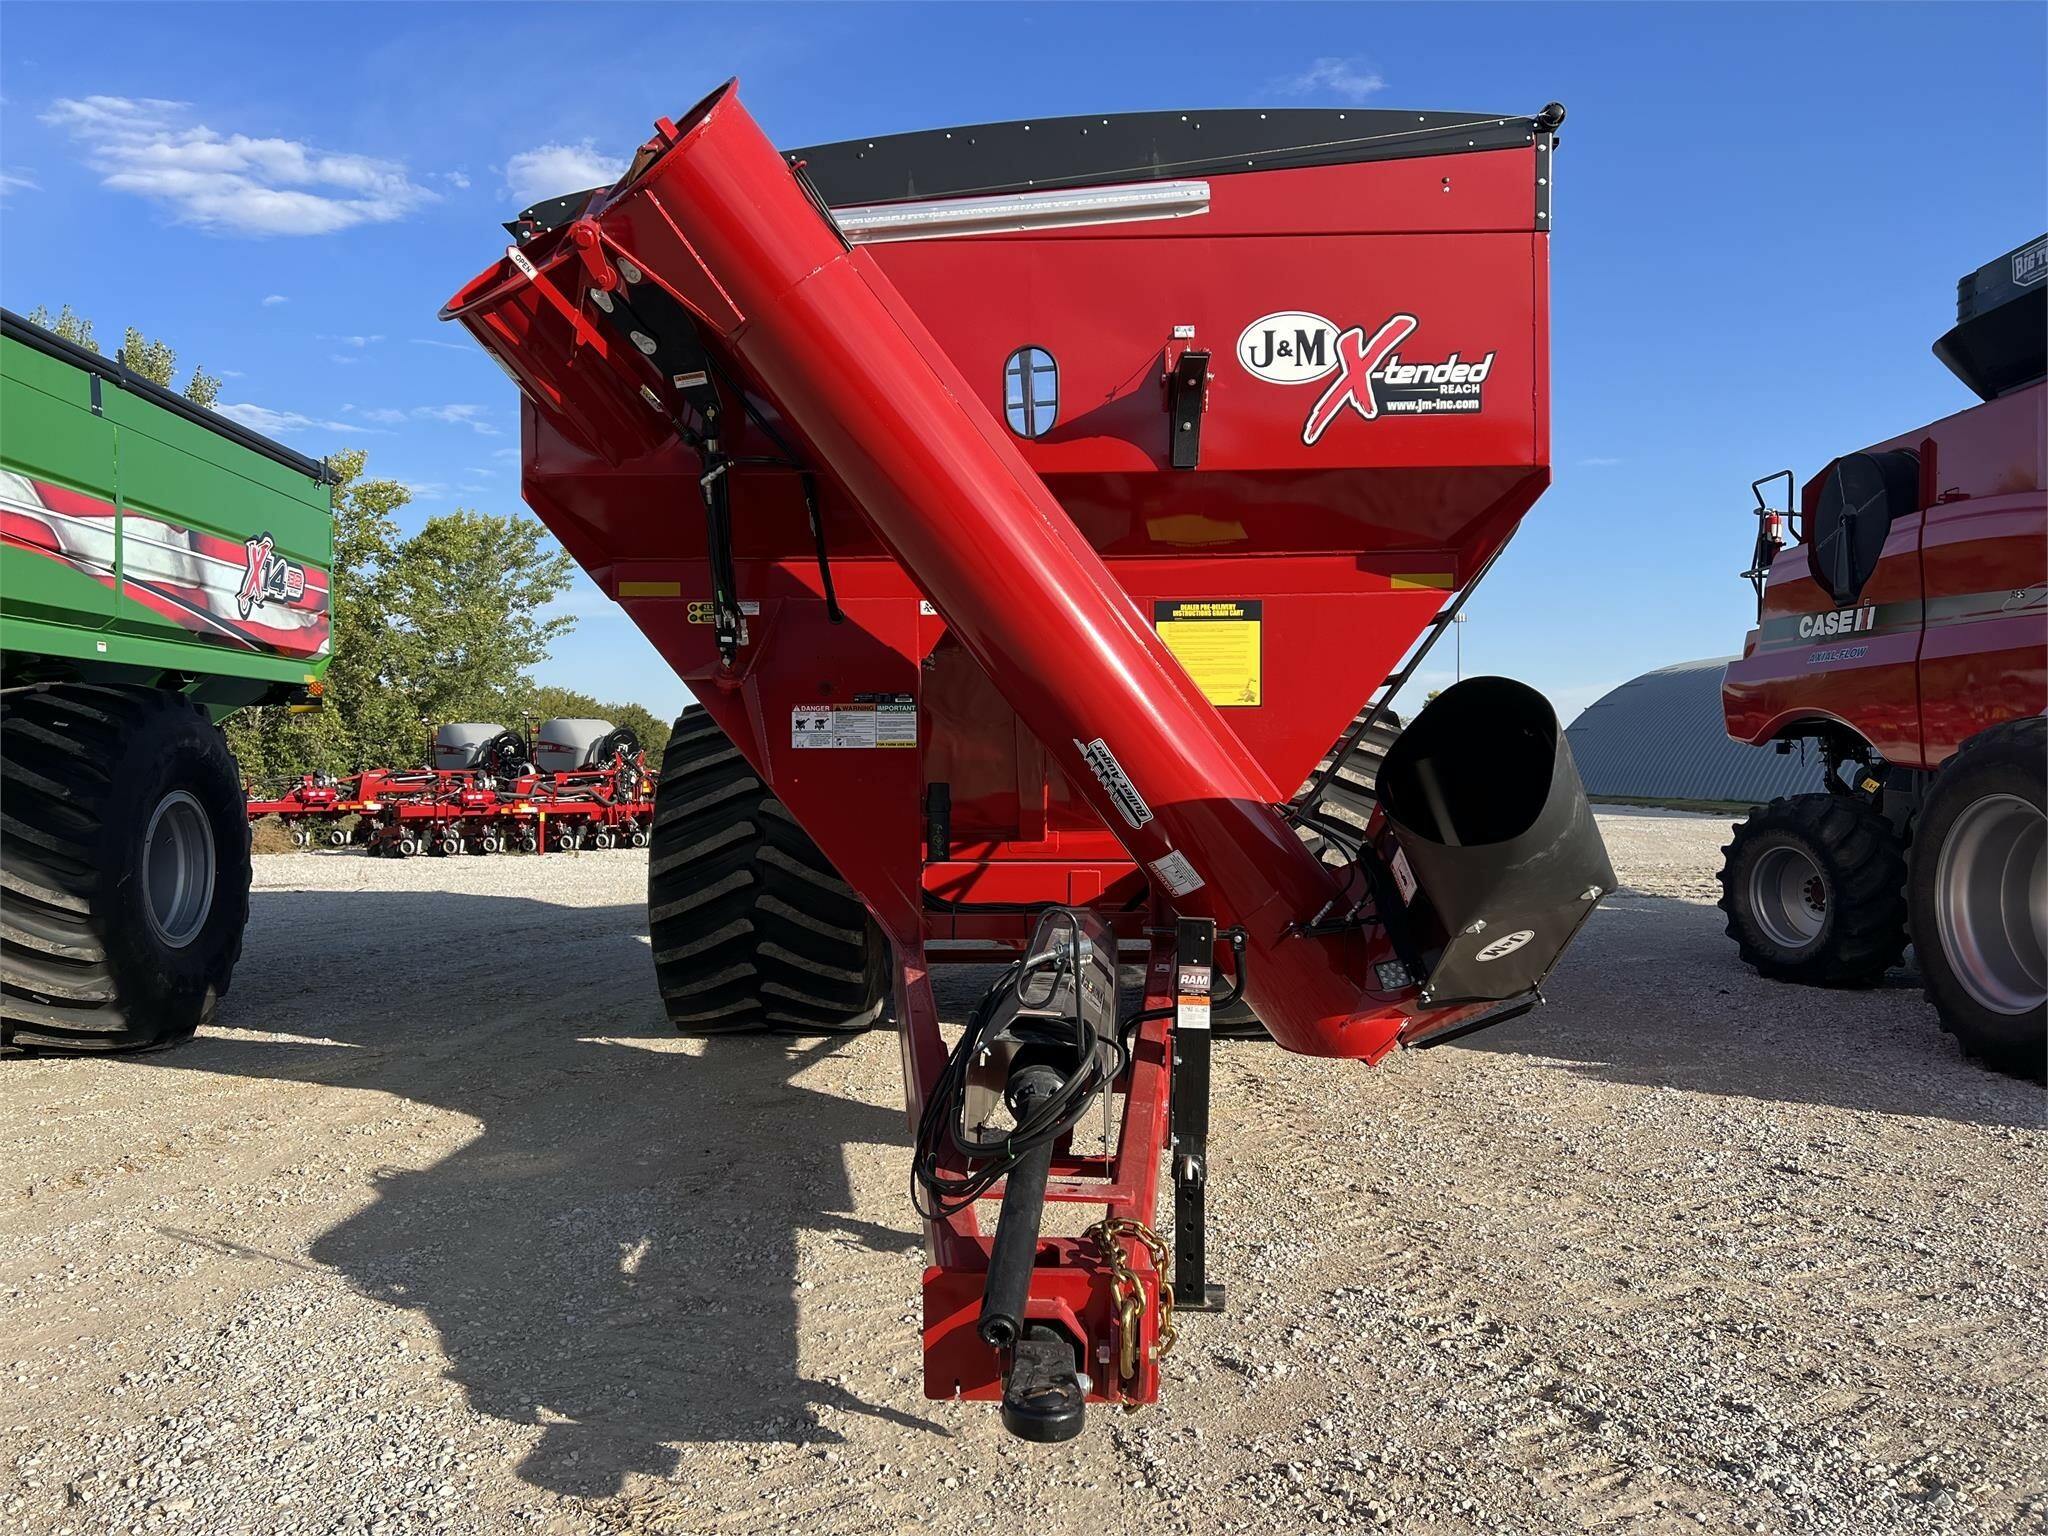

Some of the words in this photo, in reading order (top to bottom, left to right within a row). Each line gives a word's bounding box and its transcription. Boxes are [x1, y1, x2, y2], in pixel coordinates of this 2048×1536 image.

[515, 254, 532, 272] OPEN
[2015, 253, 2035, 280] BIG
[1248, 328, 1328, 368] J&M
[1440, 383, 1480, 395] REACH
[1386, 398, 1479, 413] www.jm-inc.com
[1799, 610, 1854, 638] CASE
[1809, 646, 1867, 663] AXIAL-FLOW
[1094, 745, 1122, 780] Auger
[1120, 783, 1148, 817] Bullet
[1482, 933, 1526, 957] J&M
[1181, 974, 1208, 985] RAM
